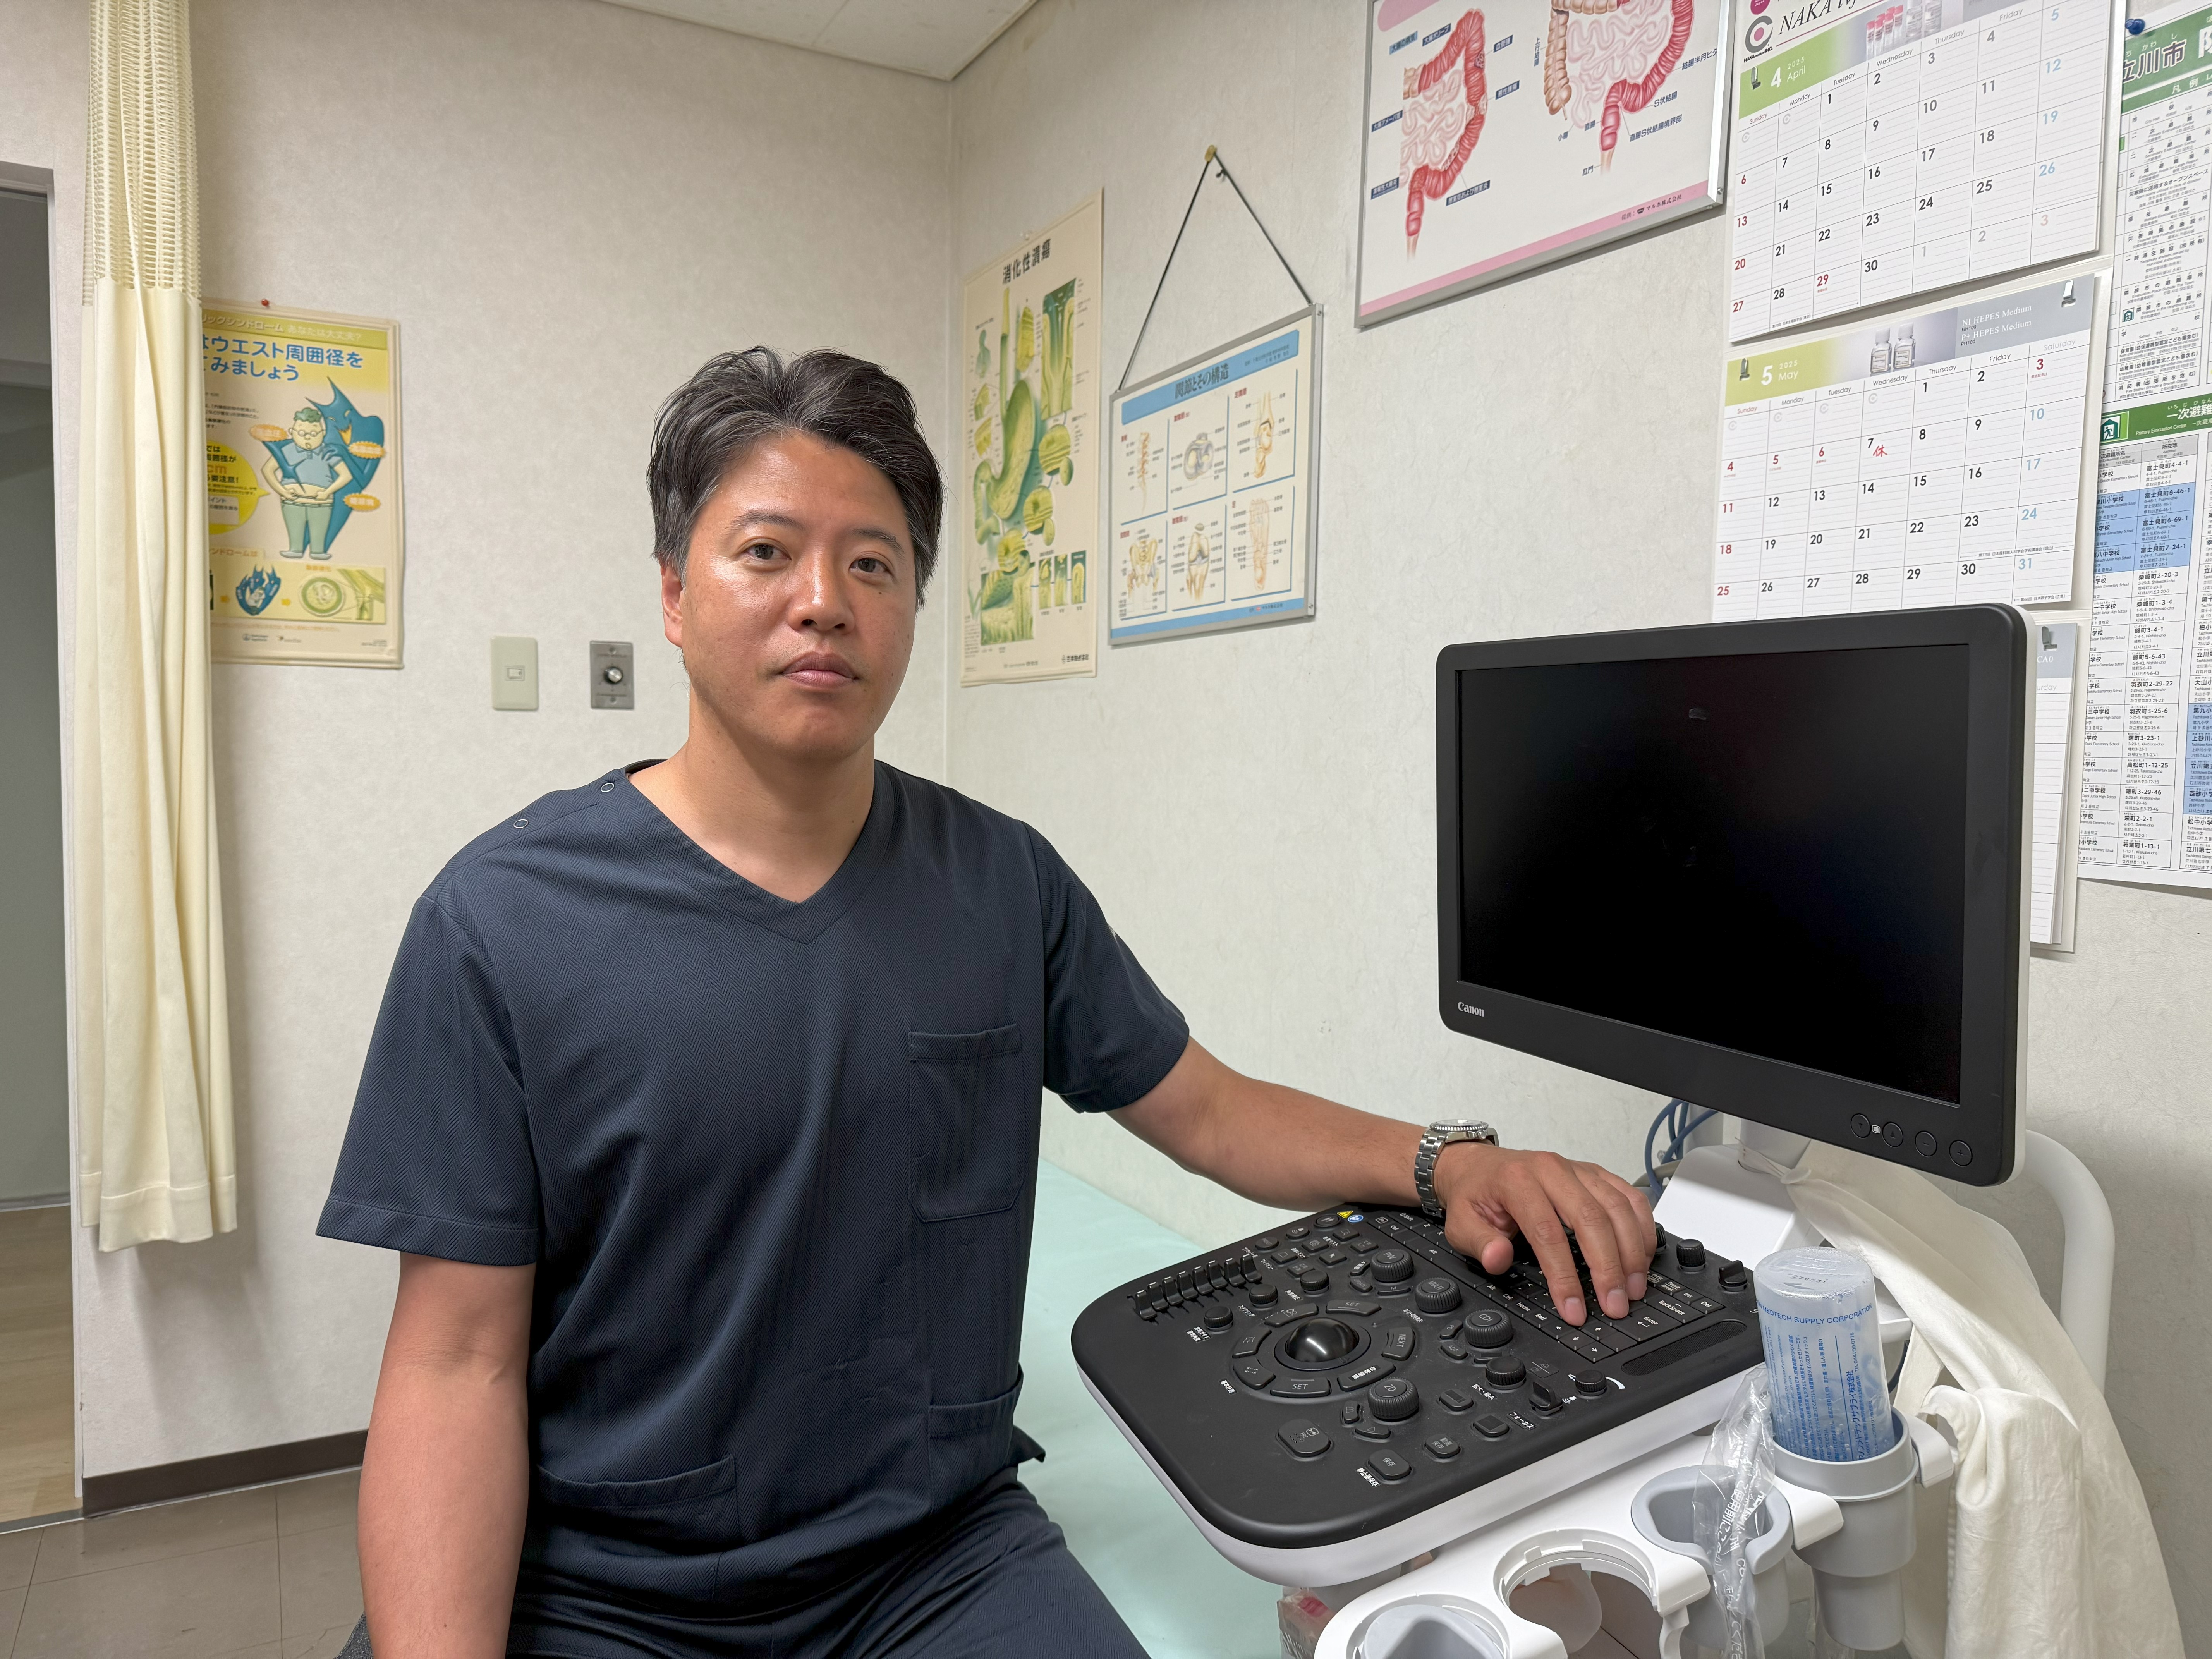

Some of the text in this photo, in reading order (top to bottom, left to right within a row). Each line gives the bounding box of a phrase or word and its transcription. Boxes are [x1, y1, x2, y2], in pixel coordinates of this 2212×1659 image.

[1779, 0, 1831, 35] NAKA
[1999, 8, 2023, 22] Friday
[2051, 8, 2059, 21] 5
[1935, 29, 1965, 45] Thursday
[1987, 30, 1995, 42] 4
[1787, 57, 1805, 70] 2025
[1877, 49, 1913, 67] Wednesday
[1928, 52, 1935, 64] 3
[2123, 39, 2187, 84] 立川市
[2045, 58, 2062, 74] 12
[1771, 66, 1805, 88] 4 April
[1834, 72, 1856, 86] Tuesday
[1874, 73, 1881, 85] 2
[1982, 80, 1995, 94] 11
[1790, 93, 1811, 106] Monday
[1827, 94, 1832, 105] 1
[1923, 100, 1937, 113] 10
[1750, 112, 1768, 125] Sunday
[2043, 110, 2059, 125] 19
[1873, 120, 1879, 131] 9
[1980, 130, 1995, 144] 18
[1825, 139, 1831, 150] 8
[1922, 148, 1936, 162] 17
[1782, 157, 1788, 168] 7
[1869, 166, 1881, 179] 16
[2039, 162, 2056, 177] 26
[1741, 175, 1747, 185] 6
[1821, 183, 1832, 196] 15
[1976, 180, 1992, 194] 25
[1646, 194, 1682, 211] マルホ株式会社
[1778, 200, 1788, 213] 14
[1918, 196, 1934, 211] 24
[1737, 216, 1748, 228] 13
[1866, 213, 1879, 227] 23
[1818, 229, 1831, 242] 22
[1775, 244, 1786, 257] 21
[1734, 258, 1746, 271] 20
[1864, 260, 1878, 273] 30
[1817, 274, 1829, 287] 29
[1773, 288, 1785, 301] 28
[1733, 301, 1744, 313] 27
[1962, 304, 2032, 327] NI HEPES Medium
[1961, 319, 2032, 341] P+ HEPES Medium
[2044, 338, 2076, 351] Saturday
[1989, 353, 2011, 363] Friday
[203, 356, 299, 381] みましょう
[1779, 360, 1798, 370] 2025
[1929, 364, 1957, 376] Thursday
[2036, 358, 2044, 371] 3
[1174, 363, 1230, 399] 関節とその構造
[1761, 365, 1799, 386] 5 May
[1873, 374, 1908, 386] Wednesday
[1977, 371, 1985, 383] 2
[1828, 386, 1851, 396] Tuesday
[1923, 382, 1928, 393] 1
[1782, 396, 1804, 406] Monday
[1737, 405, 1757, 415] Sunday
[2030, 408, 2045, 421] 10
[1975, 419, 1982, 431] 9
[1919, 429, 1926, 440] 8
[1868, 438, 1874, 449] 7
[1819, 447, 1825, 457] 6
[1872, 445, 1888, 458] 休
[1772, 455, 1779, 465] 5
[2026, 458, 2042, 471] 17
[2147, 460, 2188, 471] 富士見町4-4-1
[1727, 462, 1734, 472] 4
[1968, 467, 1982, 479] 16
[1913, 475, 1927, 487] 15
[1862, 483, 1875, 494] 14
[2145, 488, 2190, 499] 富士見町6-46-1
[1814, 490, 1826, 501] 13
[1768, 497, 1779, 507] 12
[1722, 503, 1733, 514] 11
[2021, 507, 2037, 520] 24
[1964, 515, 1980, 527] 23
[2143, 515, 2188, 526] 富士見町6-69-1
[1858, 528, 1871, 539] 21
[1909, 522, 1924, 534] 22
[1765, 539, 1776, 550] 19
[1810, 534, 1823, 545] 20
[1720, 544, 1732, 555] 18
[2141, 543, 2186, 553] 富士見町7-24-1
[1961, 563, 1976, 575] 30
[2018, 558, 2033, 570] 31
[1855, 573, 1869, 584] 28
[1906, 568, 1921, 580] 29
[1761, 582, 1773, 592] 26
[1807, 578, 1820, 589] 27
[1717, 586, 1729, 596] 25
[1457, 1001, 1485, 1017] Canon
[1383, 1251, 1397, 1260] PW
[1427, 1280, 1445, 1291] MULTI
[1516, 1302, 1531, 1312] Home
[1479, 1313, 1494, 1323] CDI
[1762, 1305, 1792, 1322] MEDTECH
[1827, 1303, 1872, 1324] CORPORATION
[1643, 1316, 1658, 1325] Enter
[1396, 1334, 1407, 1348] NEXT
[1447, 1345, 1459, 1353] ADF
[1384, 1383, 1397, 1393] 2D
[1510, 1412, 1534, 1430] フォーカス
